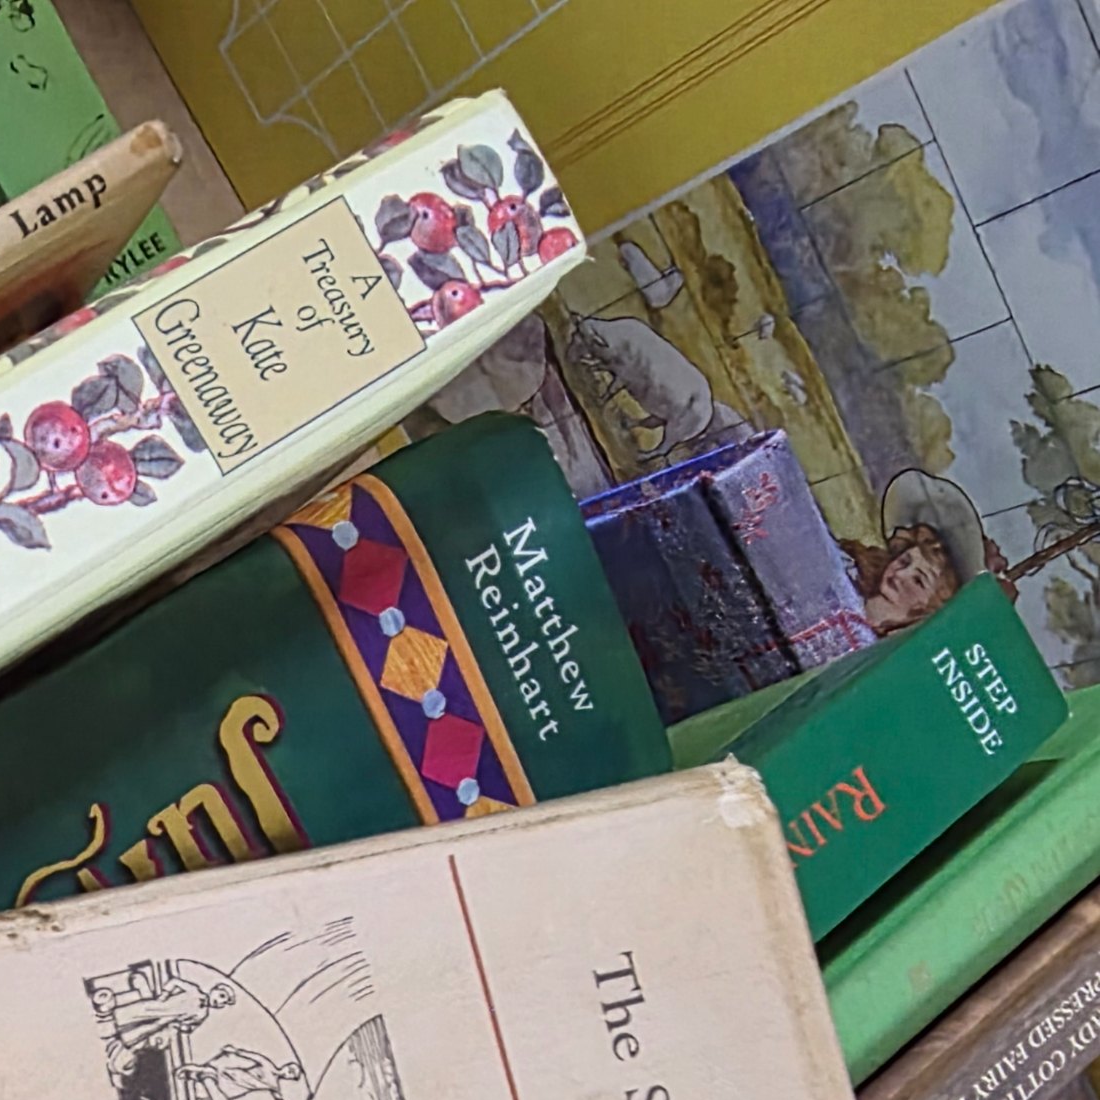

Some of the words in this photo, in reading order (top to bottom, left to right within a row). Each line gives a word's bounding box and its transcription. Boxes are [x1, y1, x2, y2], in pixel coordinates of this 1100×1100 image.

[9, 173, 117, 240] Lamp
[295, 304, 337, 333] of
[302, 238, 376, 358] Treasury
[350, 274, 384, 302] A
[134, 298, 260, 460] Greenaway
[231, 304, 289, 382] Kate
[464, 543, 581, 742] Reinhart
[490, 516, 595, 711] Matthew
[931, 647, 1004, 756] INSIDE
[964, 643, 1018, 715] STEP
[592, 950, 646, 1063] The
